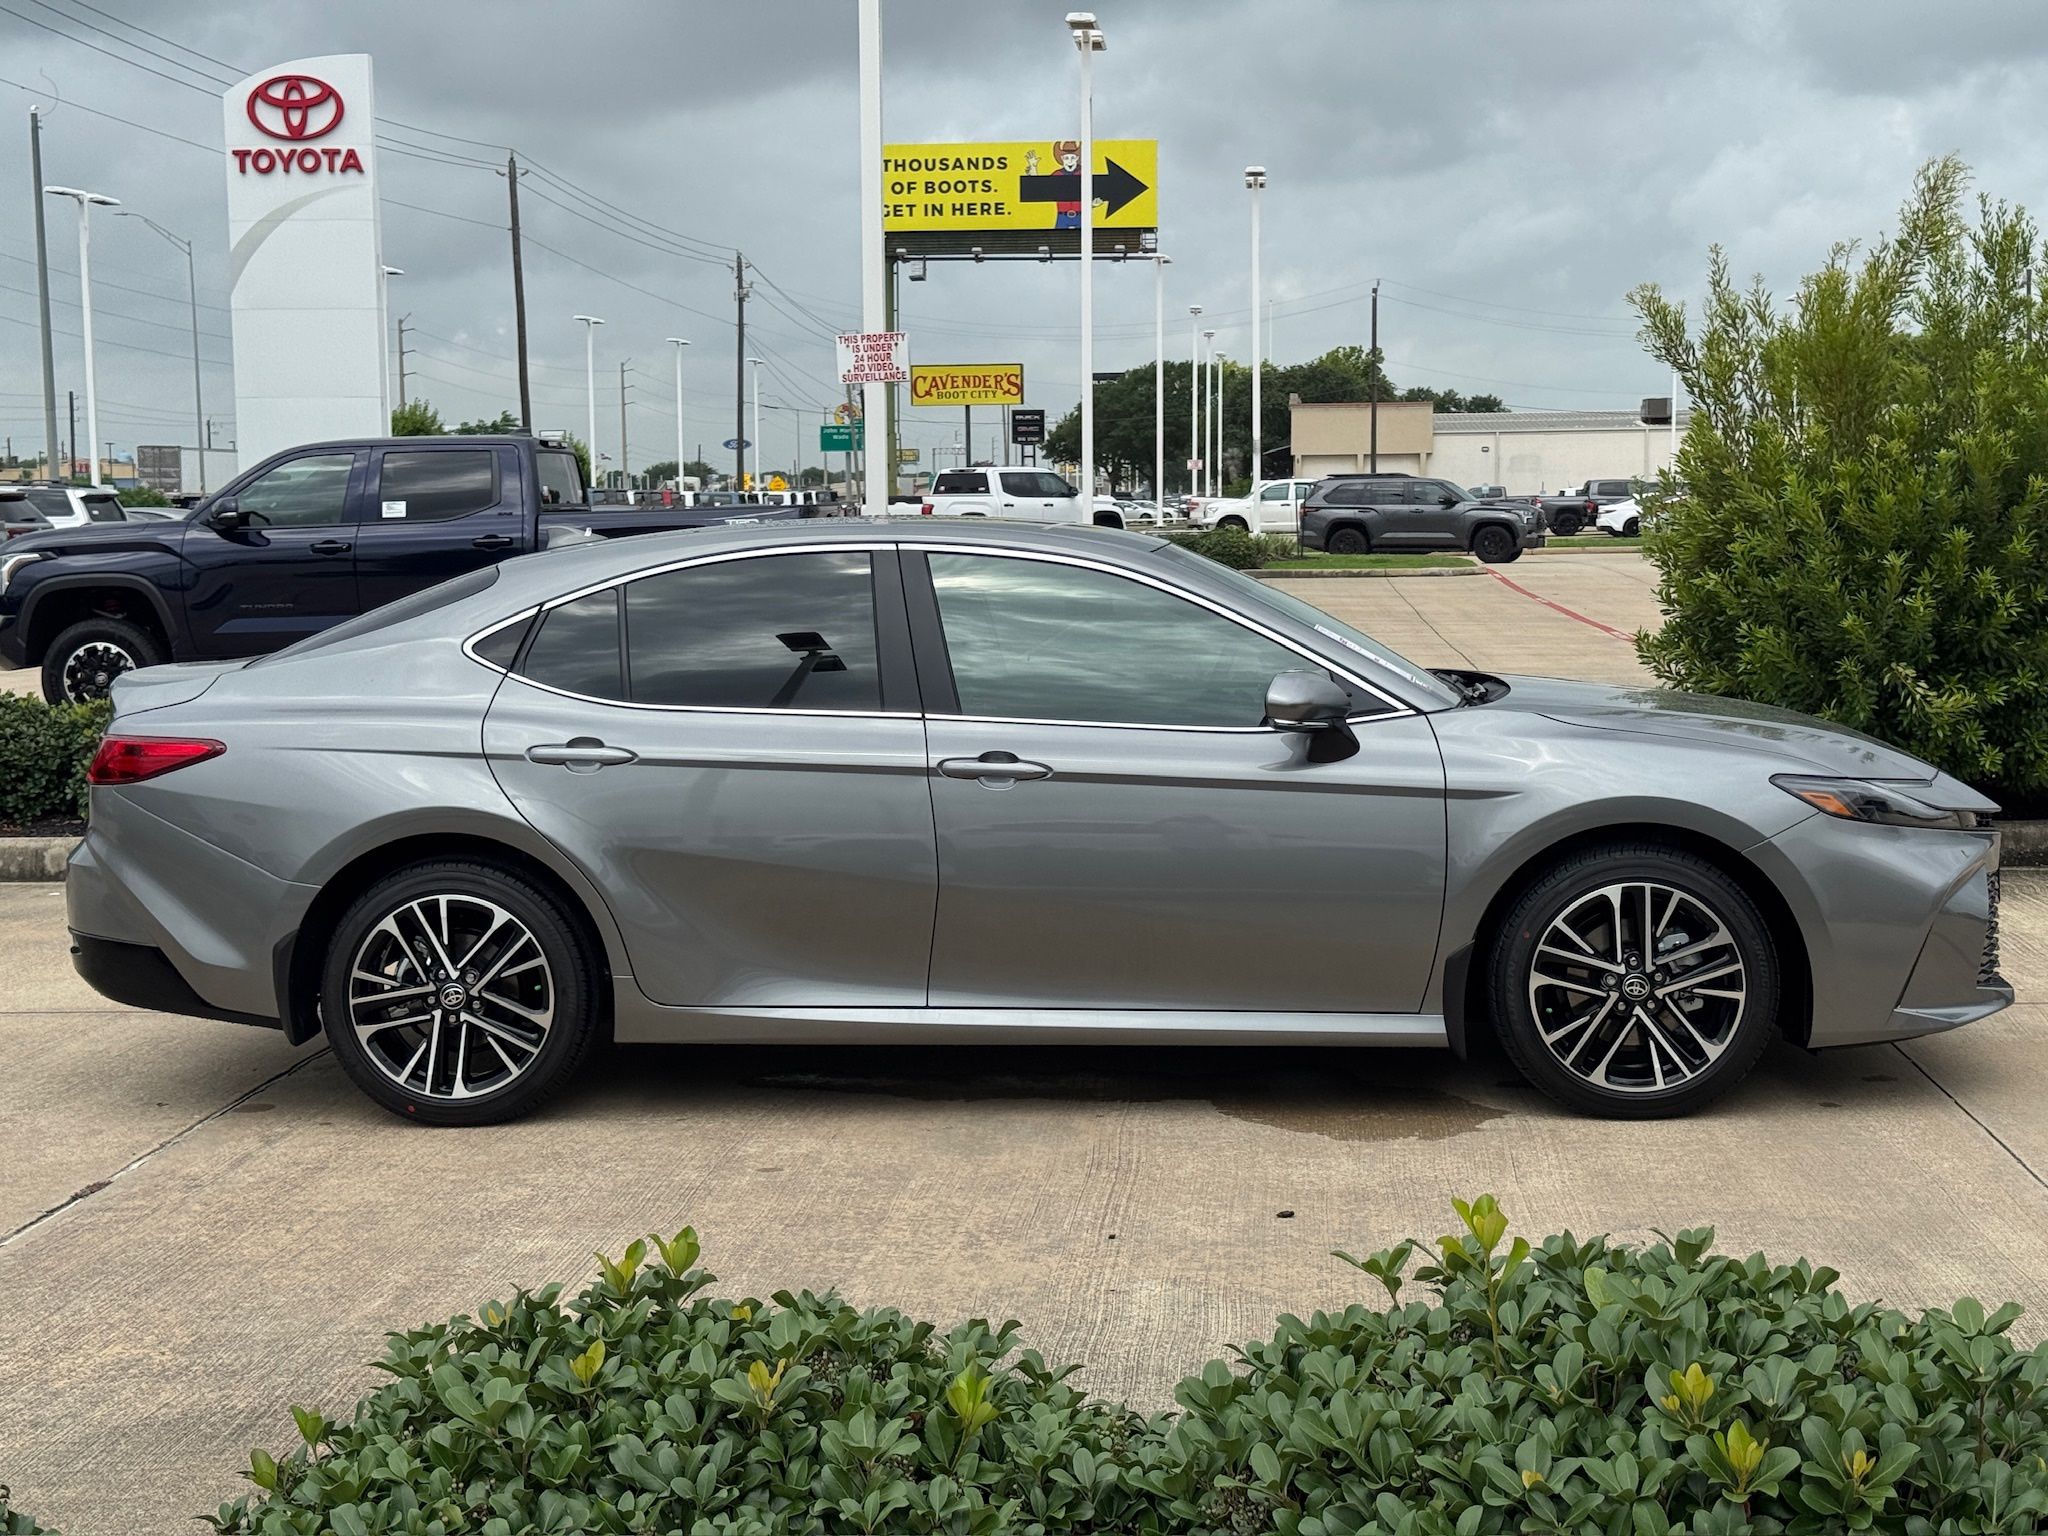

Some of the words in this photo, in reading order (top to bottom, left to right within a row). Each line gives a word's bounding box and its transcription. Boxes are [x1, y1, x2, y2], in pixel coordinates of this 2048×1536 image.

[231, 148, 364, 174] TOYOTA
[883, 157, 1008, 172] THOUSANDS
[891, 181, 917, 195] OF
[924, 179, 998, 194] BOOTS.
[924, 203, 944, 217] IN
[951, 202, 1012, 216] HERE.
[838, 335, 858, 344] THIS
[861, 333, 906, 343] PROPERTY
[852, 344, 861, 353] IS
[863, 343, 893, 353] UNDER
[854, 354, 865, 363] 24
[867, 352, 892, 362] HOUR
[853, 364, 865, 373] HD
[867, 362, 894, 372] VIDEO
[842, 371, 907, 382] SURVEILLANCE
[913, 372, 1021, 398] CAVENDER'S
[936, 391, 968, 399] BOOT
[970, 390, 998, 398] CITY
